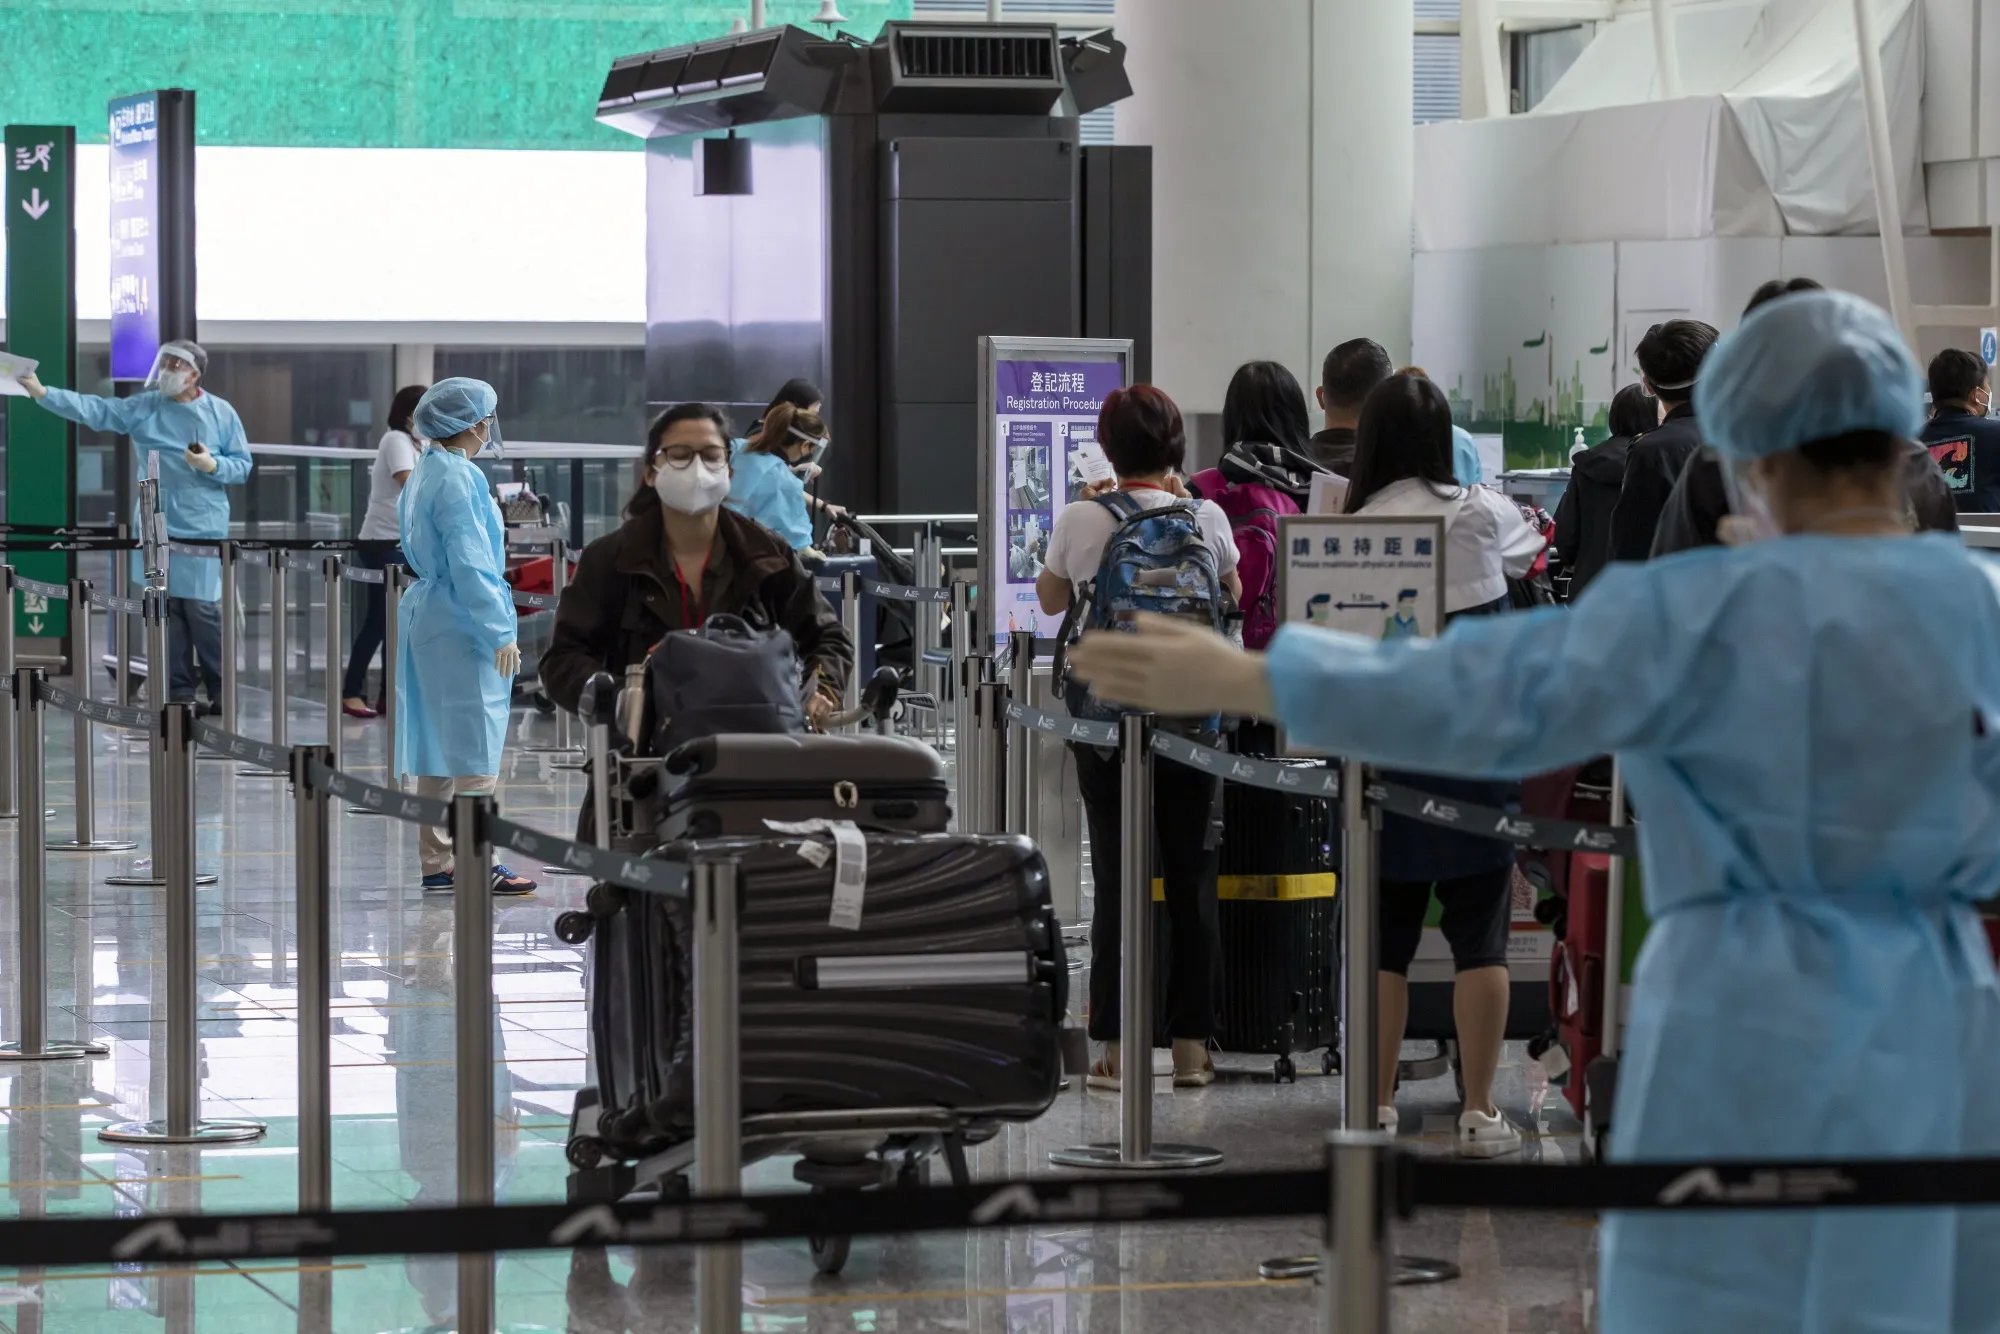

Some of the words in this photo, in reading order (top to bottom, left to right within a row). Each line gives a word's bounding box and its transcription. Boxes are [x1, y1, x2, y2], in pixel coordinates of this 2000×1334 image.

[1985, 336, 1993, 358] 4
[1031, 372, 1085, 393] 登記流程
[1006, 395, 1060, 411] Registration
[1063, 396, 1104, 410] Procedur
[1060, 424, 1066, 434] 2
[1292, 537, 1432, 556] 請保持距離
